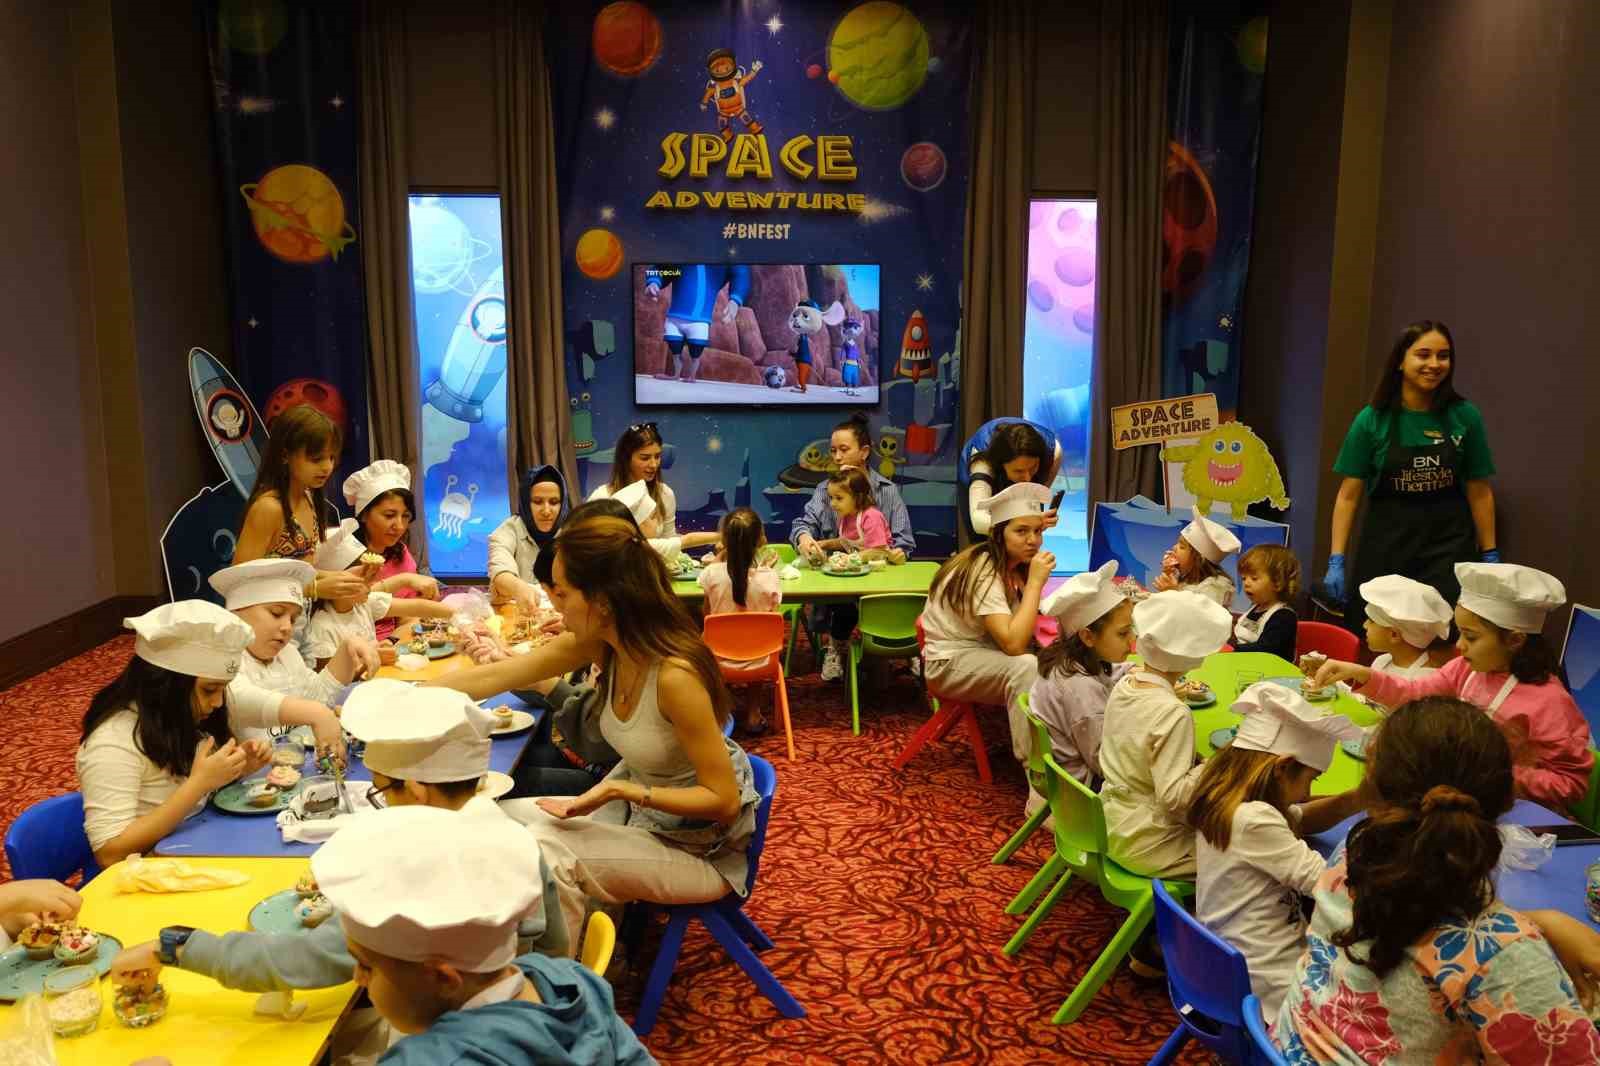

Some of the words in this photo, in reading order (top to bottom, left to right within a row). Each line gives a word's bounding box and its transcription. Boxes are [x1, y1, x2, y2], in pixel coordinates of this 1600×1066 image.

[657, 132, 858, 181] SPACE
[645, 191, 866, 211] ADVENTURE
[722, 223, 791, 240] #BNFEST
[1130, 401, 1194, 427] SPACE
[1119, 418, 1212, 442] ADVENTURE
[1413, 455, 1440, 468] BN
